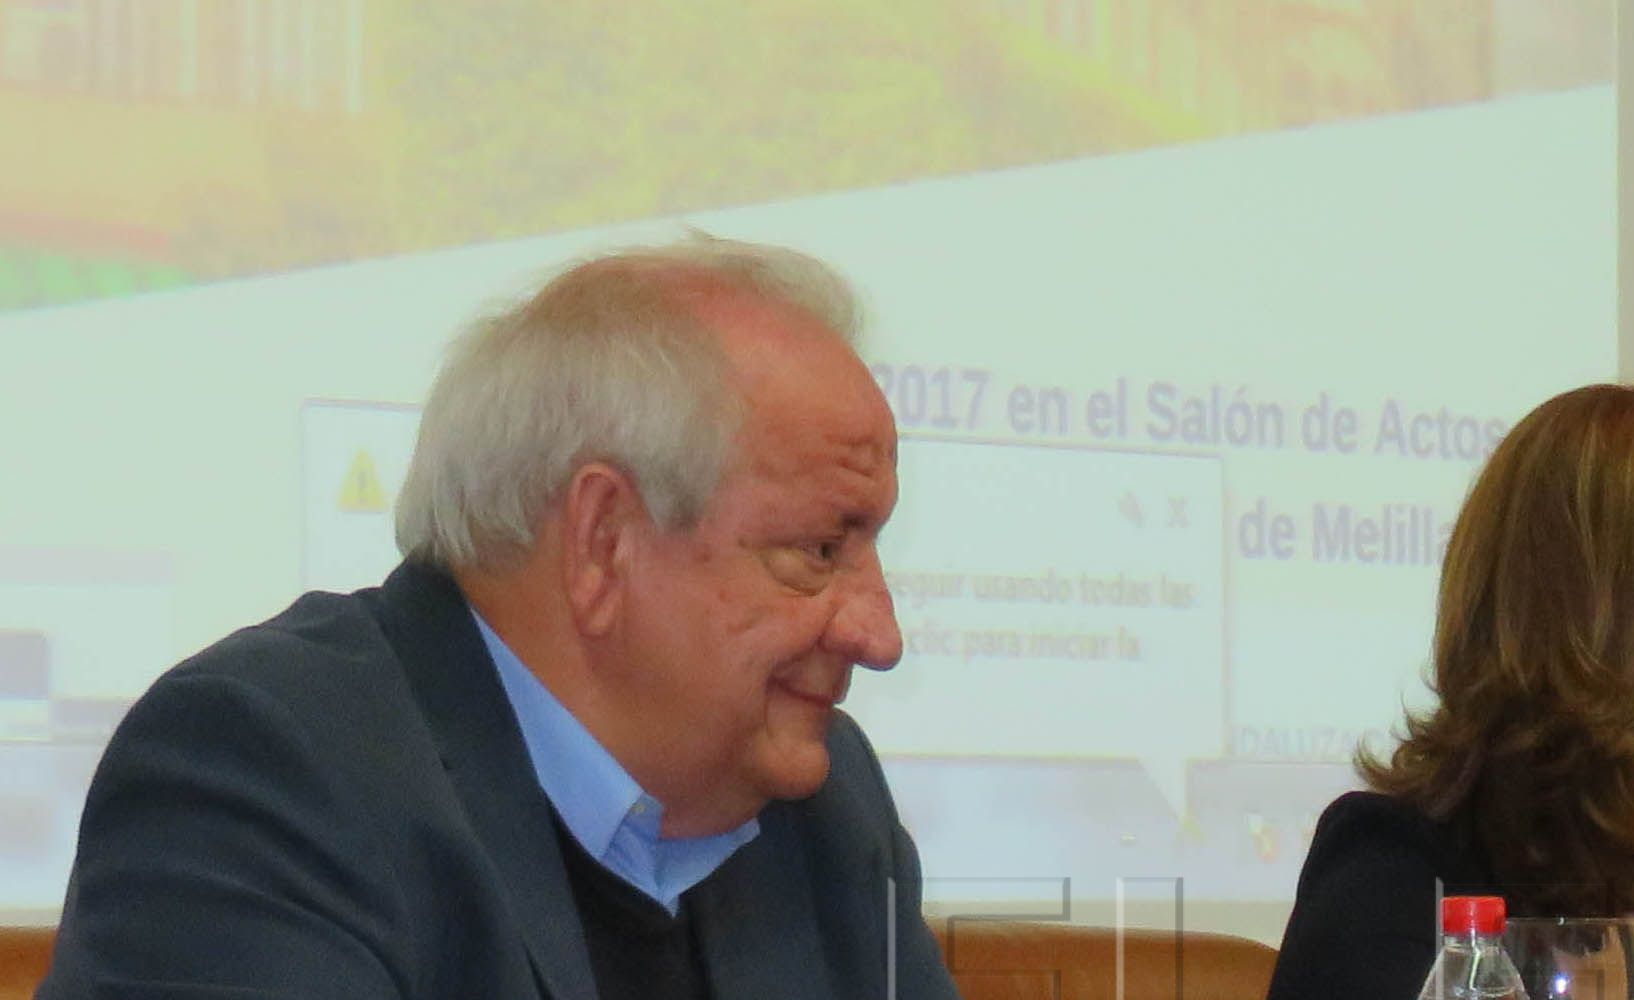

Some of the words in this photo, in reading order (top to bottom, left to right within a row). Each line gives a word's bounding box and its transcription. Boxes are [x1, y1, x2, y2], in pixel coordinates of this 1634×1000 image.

[1007, 384, 1071, 435] en
[1086, 376, 1128, 439] el
[1146, 378, 1285, 449] Salón
[1300, 389, 1359, 454] de
[1373, 397, 1508, 462] Actos
[1238, 498, 1297, 560] de
